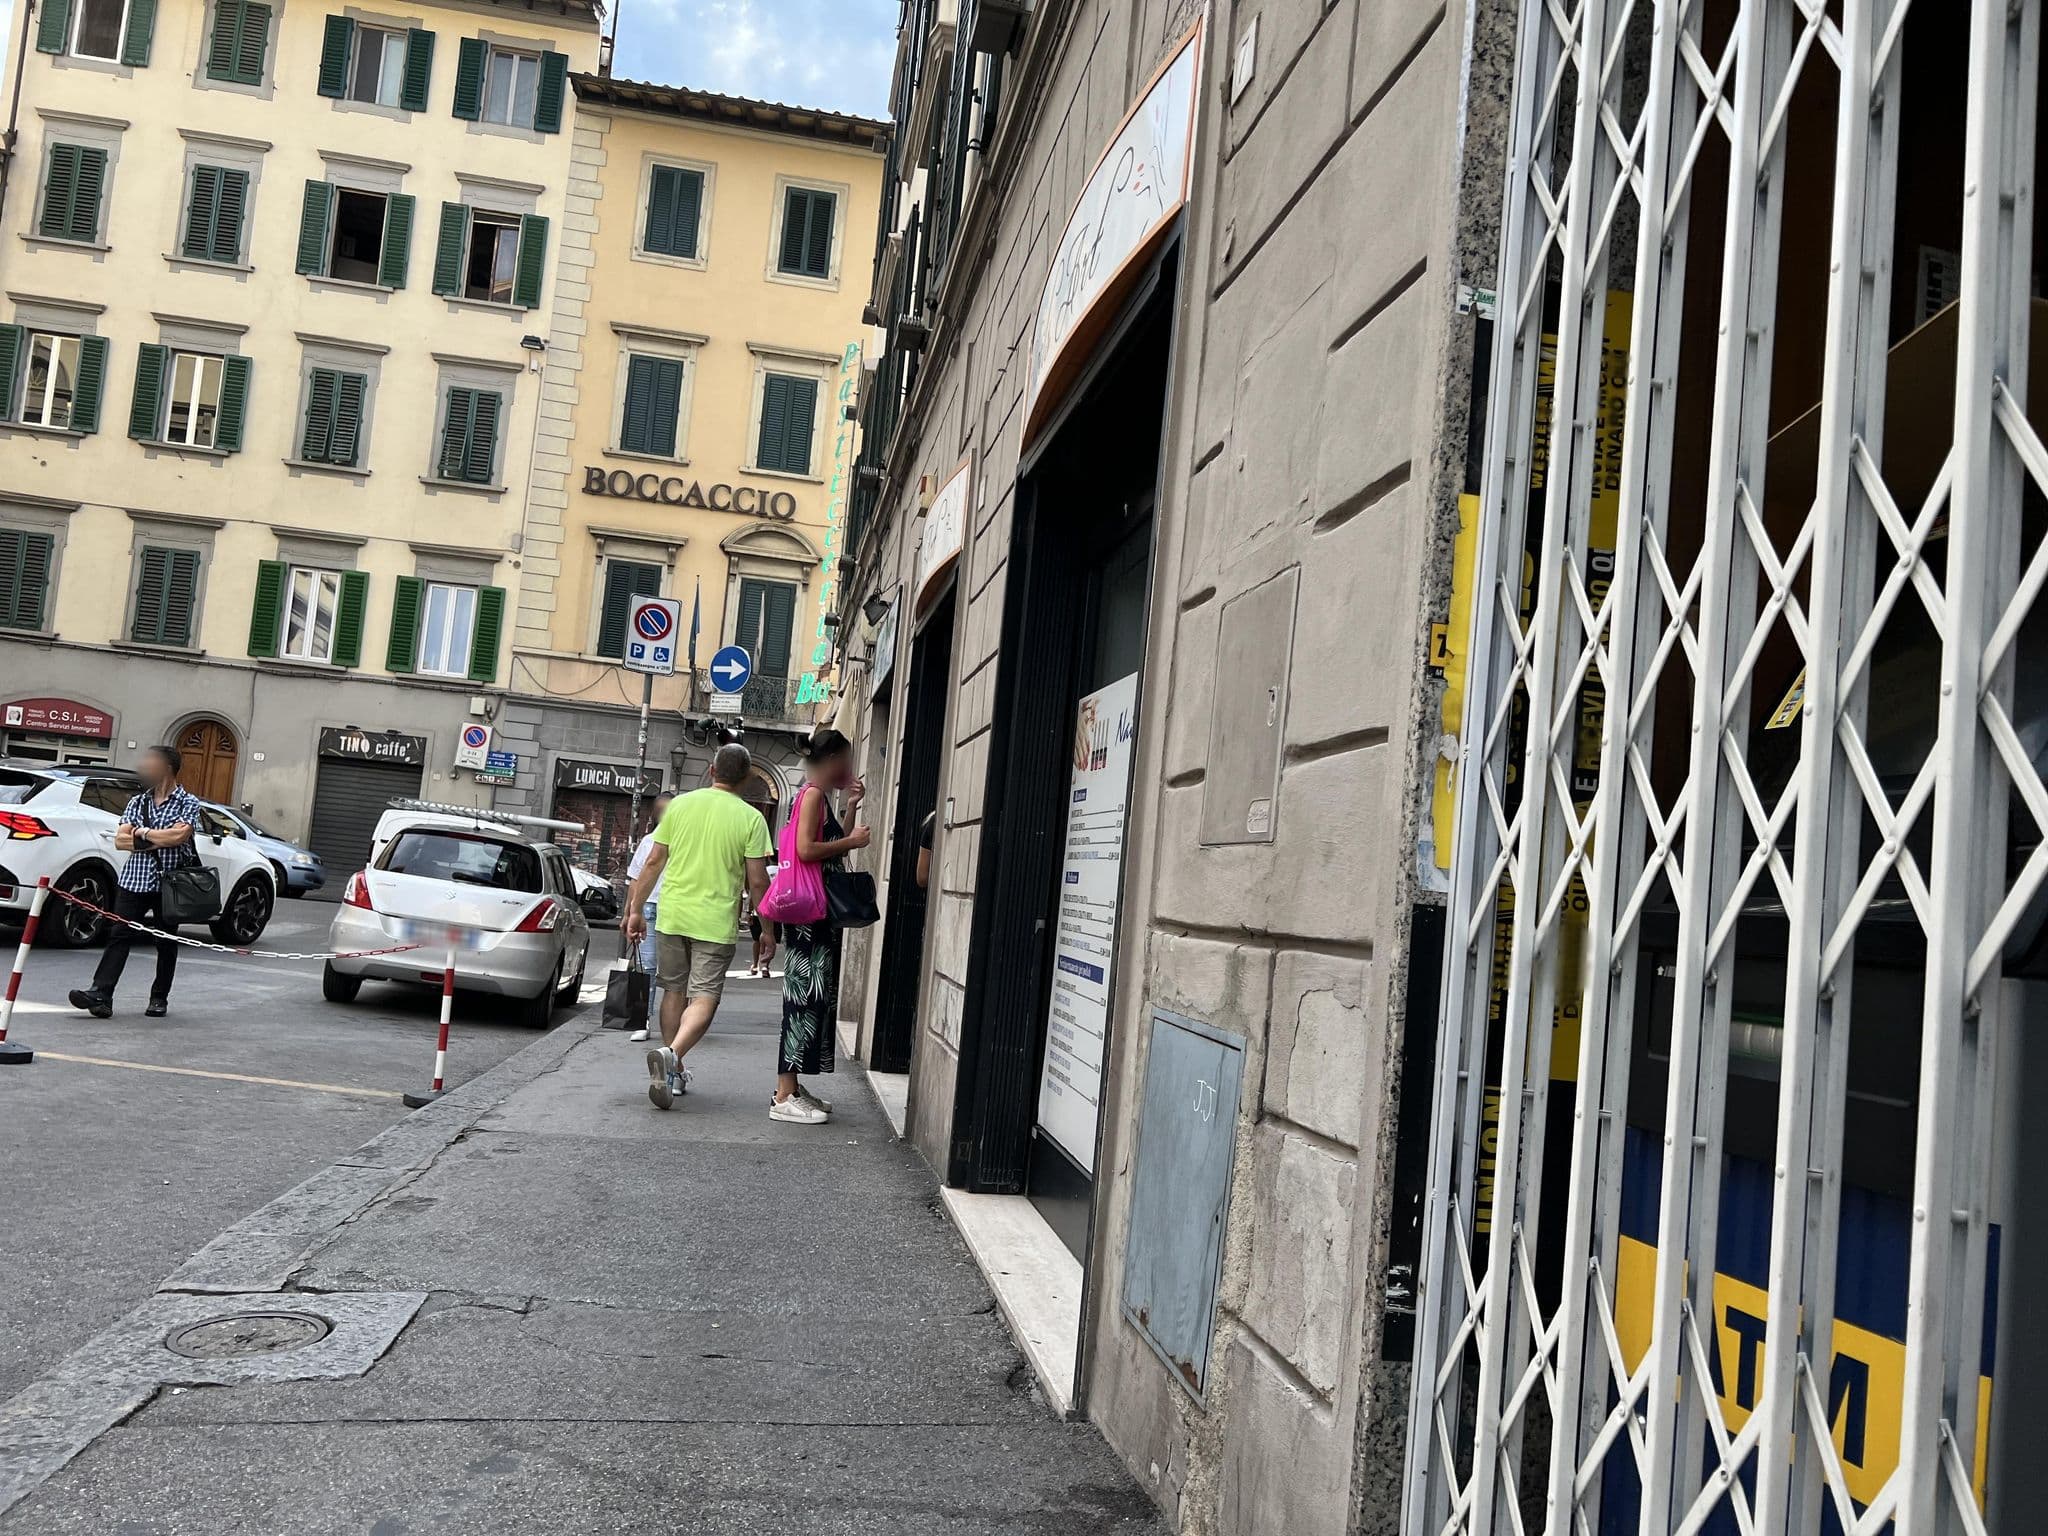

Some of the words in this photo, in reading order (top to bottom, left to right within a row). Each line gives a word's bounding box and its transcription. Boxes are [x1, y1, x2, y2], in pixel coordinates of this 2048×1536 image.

[582, 466, 796, 519] BOCCACCIO
[633, 645, 643, 658] P
[1437, 633, 1447, 658] 7
[49, 710, 80, 722] C.S.I.
[26, 719, 47, 728] Centro
[48, 721, 70, 730] Servizi
[71, 725, 100, 734] Immigrati
[575, 767, 610, 786] LUNCH
